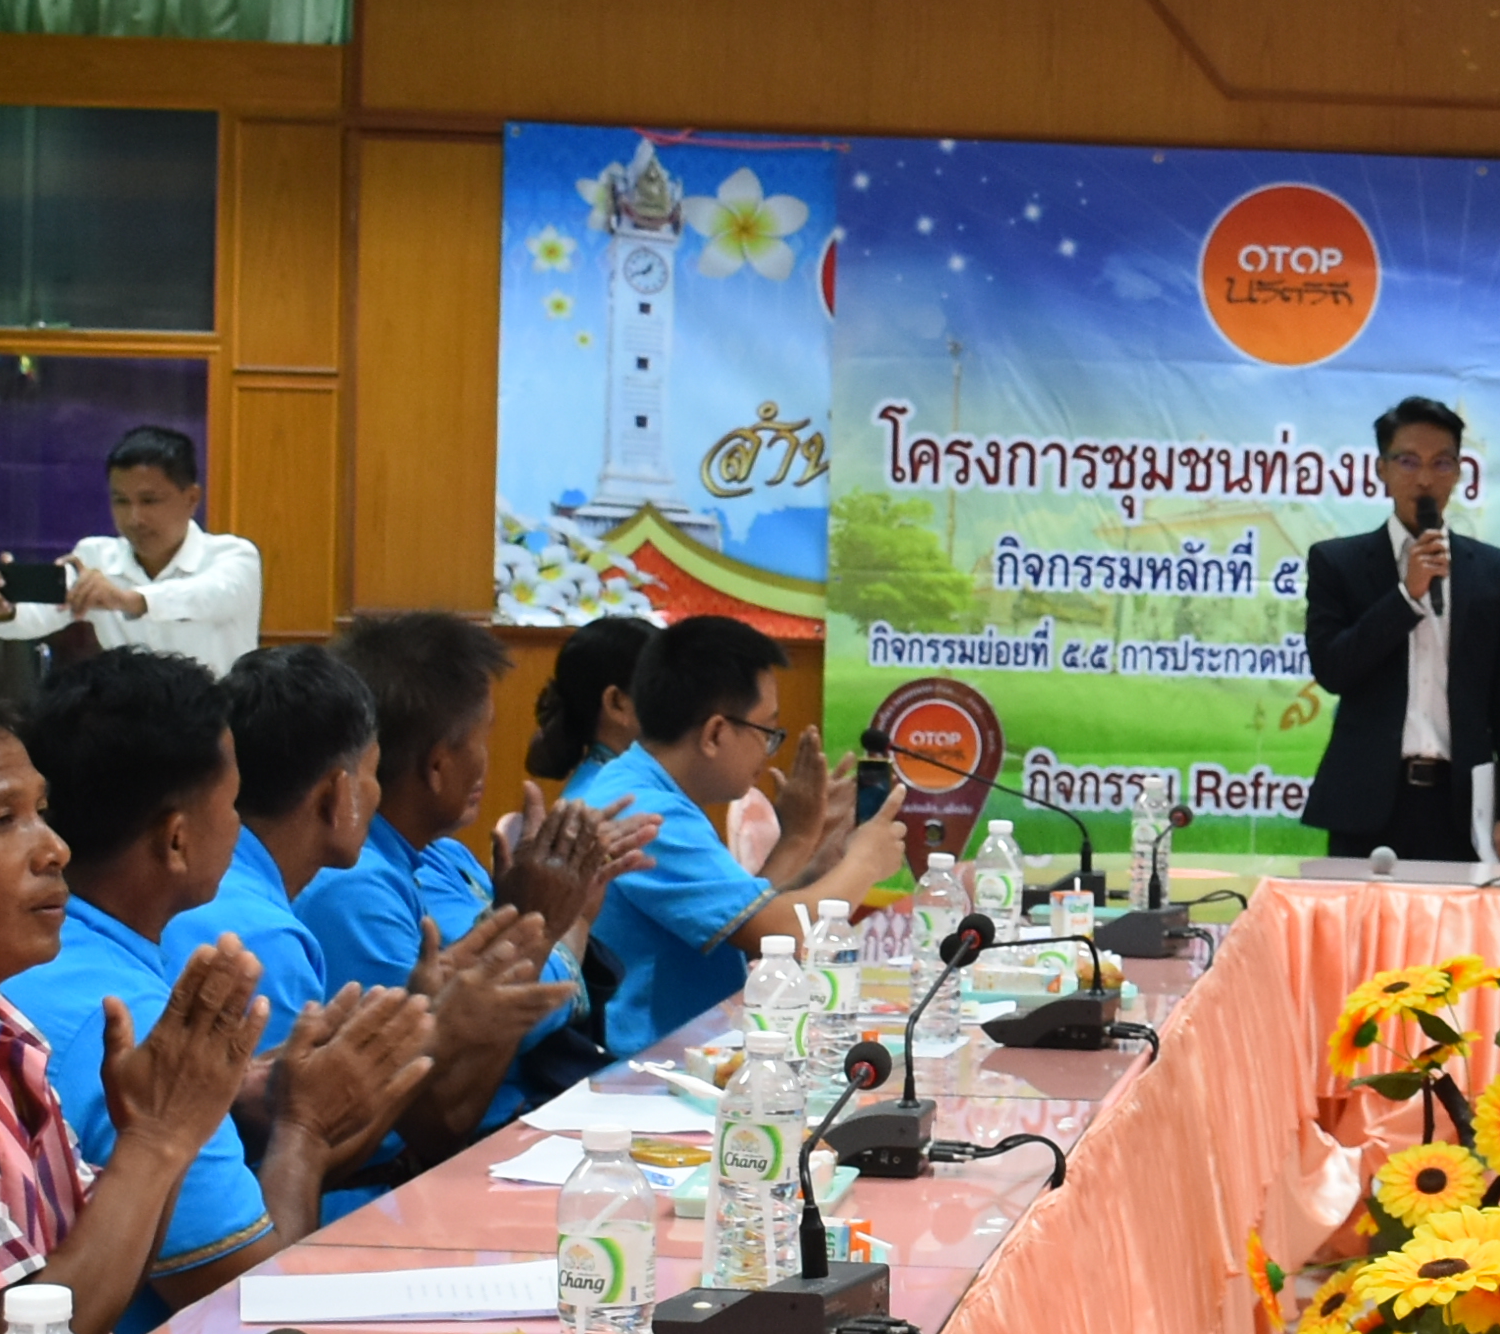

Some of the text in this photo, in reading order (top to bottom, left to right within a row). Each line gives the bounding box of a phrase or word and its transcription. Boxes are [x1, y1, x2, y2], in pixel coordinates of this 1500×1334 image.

[1238, 243, 1343, 275] OTOP
[878, 404, 1481, 519] โครงการชุมชนท่องเว
[995, 531, 1299, 595] กิจกรรมหลักที่ ๕
[870, 620, 1050, 666] กิจกรรมย่อยที่
[909, 731, 962, 746] OTOP
[1196, 770, 1303, 811] Refre
[724, 1151, 769, 1172] Chang
[560, 1269, 606, 1294] Chang
